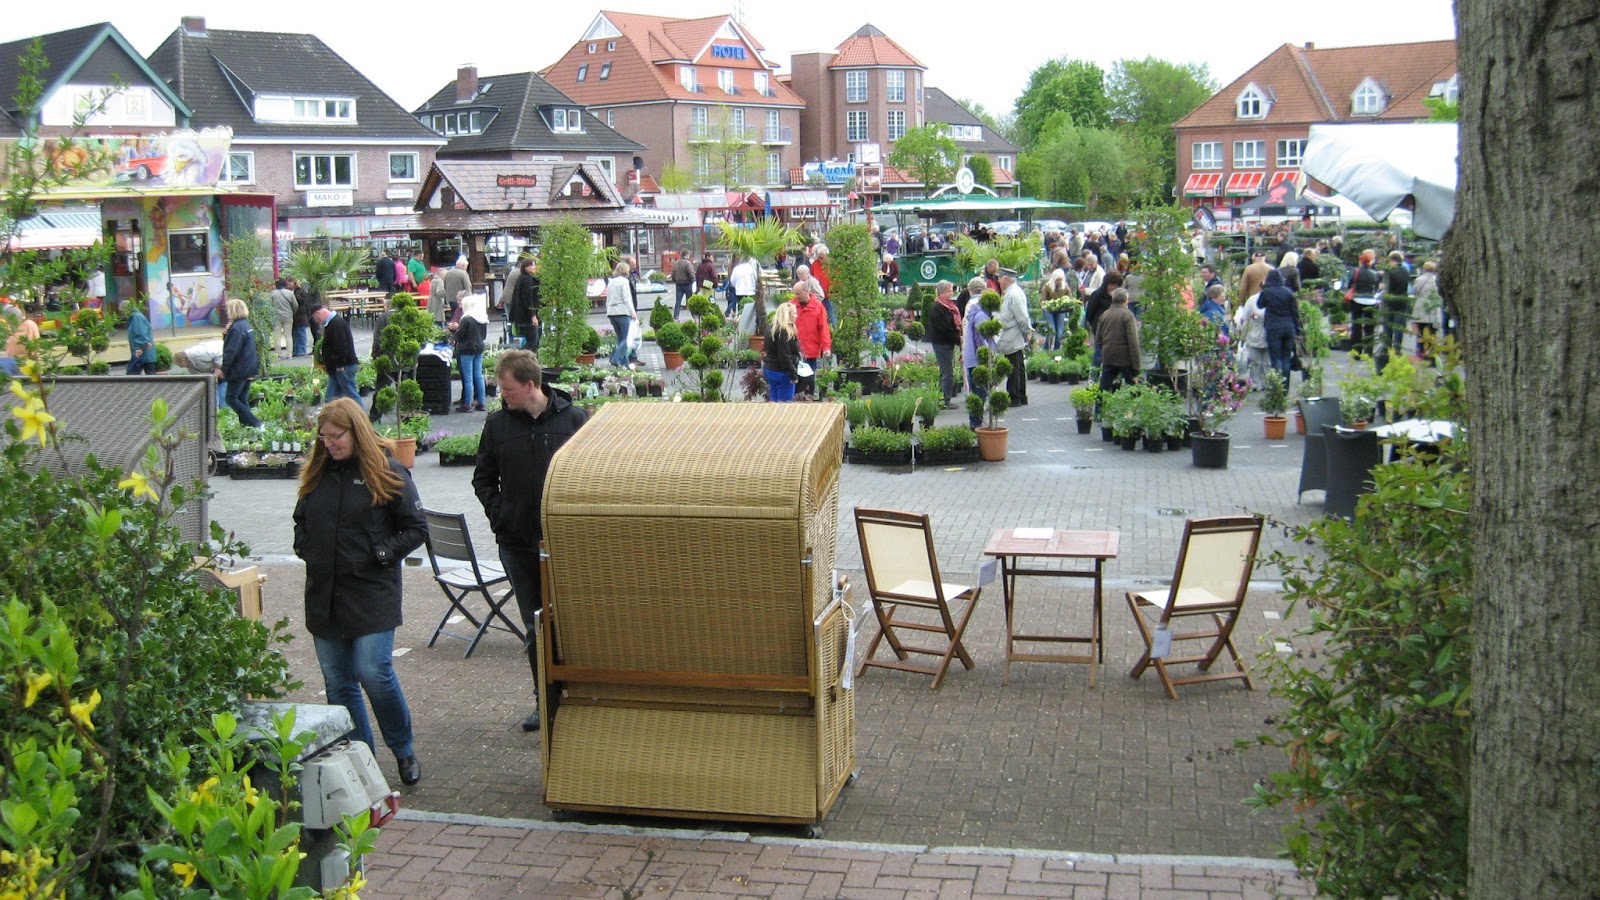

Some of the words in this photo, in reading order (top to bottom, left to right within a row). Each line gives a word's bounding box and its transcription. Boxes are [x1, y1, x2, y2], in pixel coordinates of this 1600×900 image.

[712, 45, 747, 59] HOTEL
[815, 163, 854, 175] Auerh
[314, 193, 340, 201] MAKO
